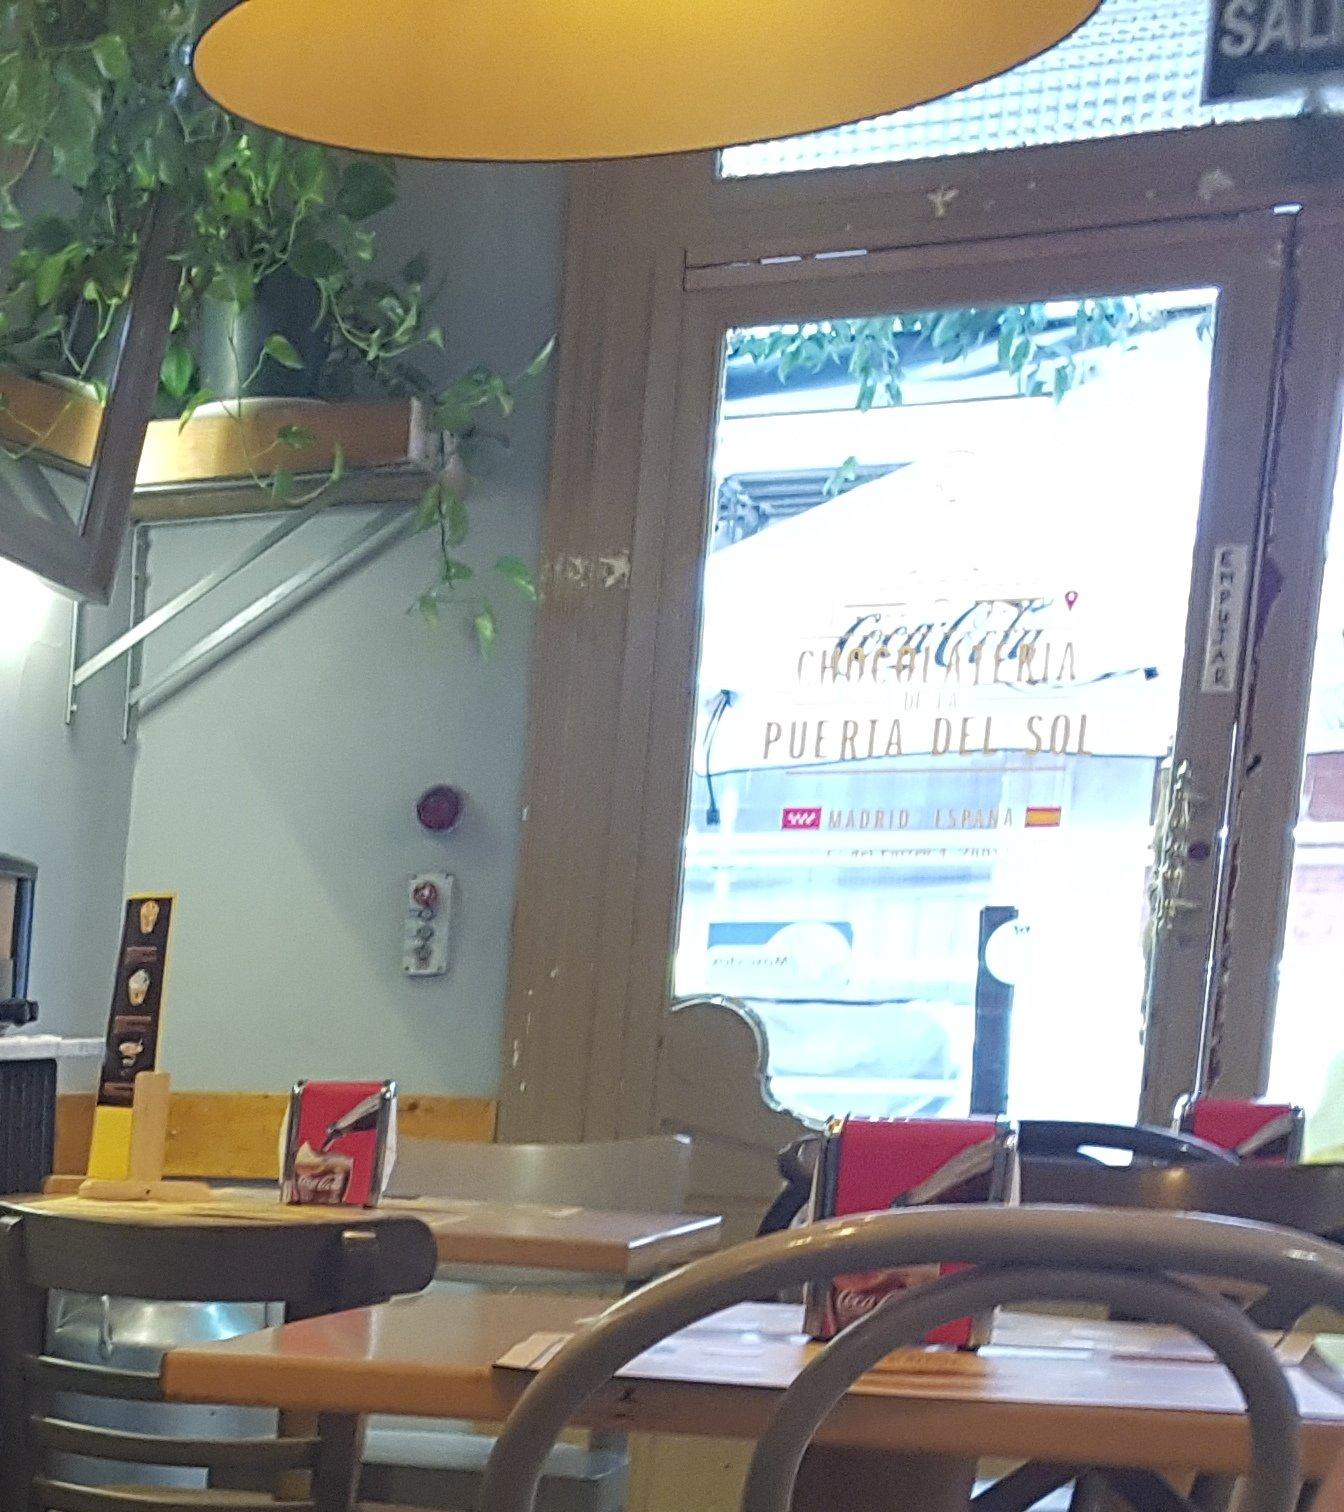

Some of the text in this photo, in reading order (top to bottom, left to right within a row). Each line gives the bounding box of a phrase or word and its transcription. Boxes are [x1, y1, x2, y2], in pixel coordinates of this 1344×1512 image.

[762, 714, 1093, 761] PUERTA DEL SOL
